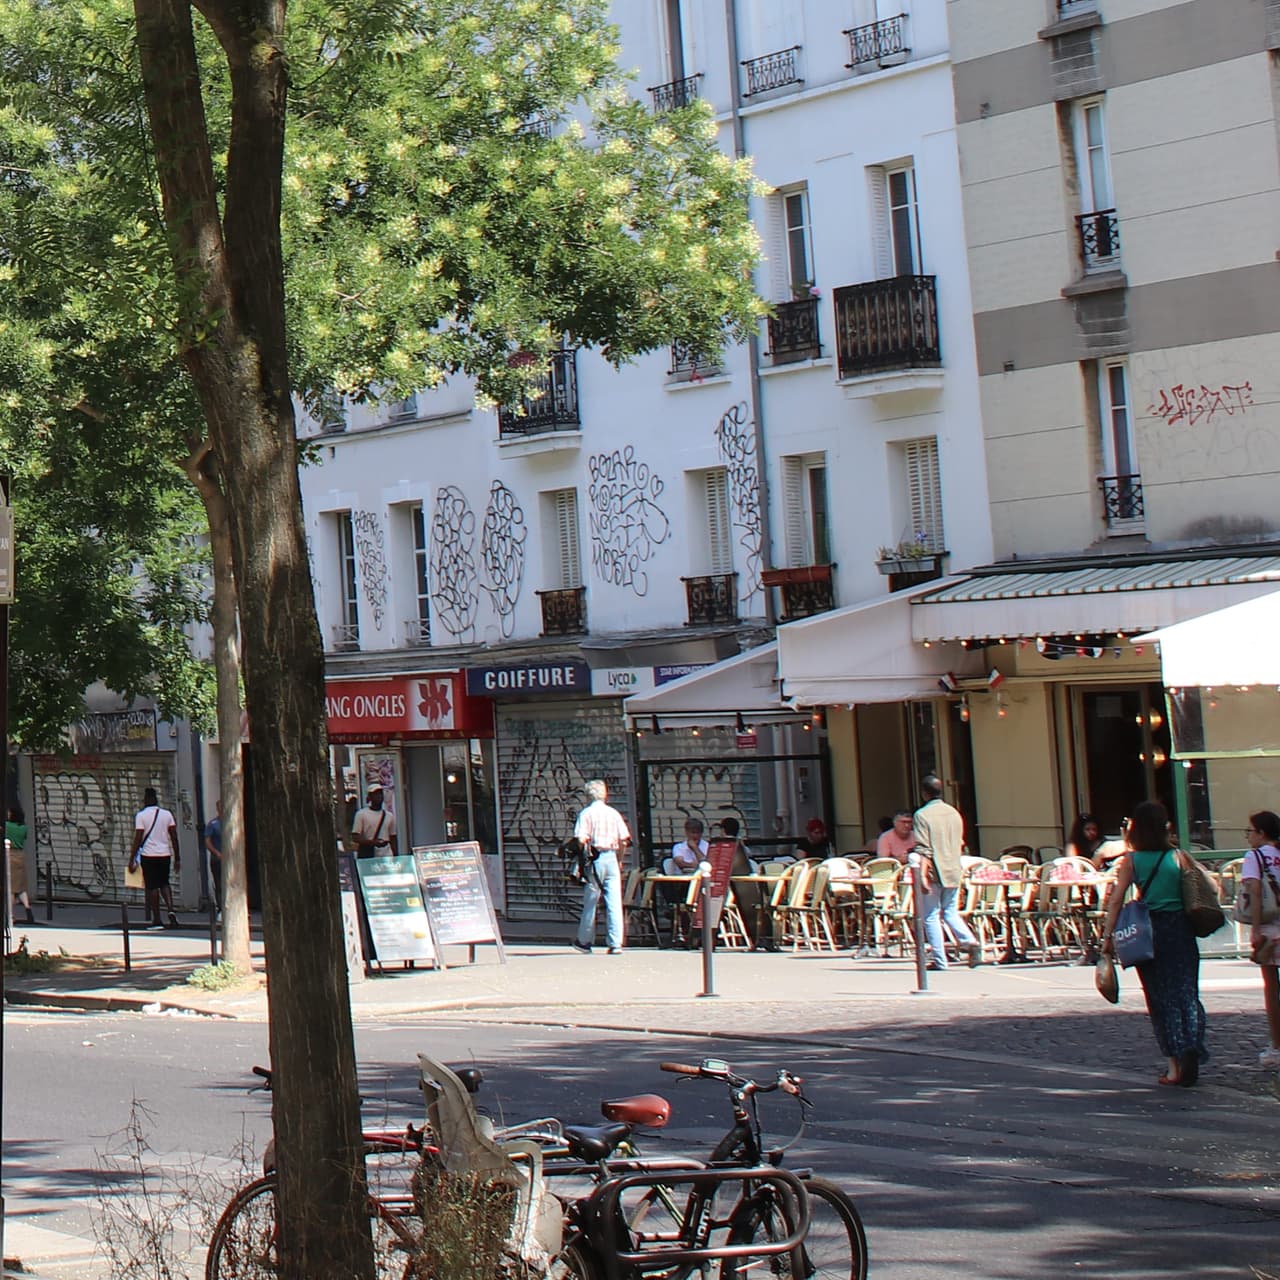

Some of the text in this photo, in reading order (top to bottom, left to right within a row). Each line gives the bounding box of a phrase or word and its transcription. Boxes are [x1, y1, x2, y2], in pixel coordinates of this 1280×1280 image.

[484, 666, 576, 690] COIFFURE
[608, 671, 630, 688] Lyca
[353, 694, 406, 718] ONGLES
